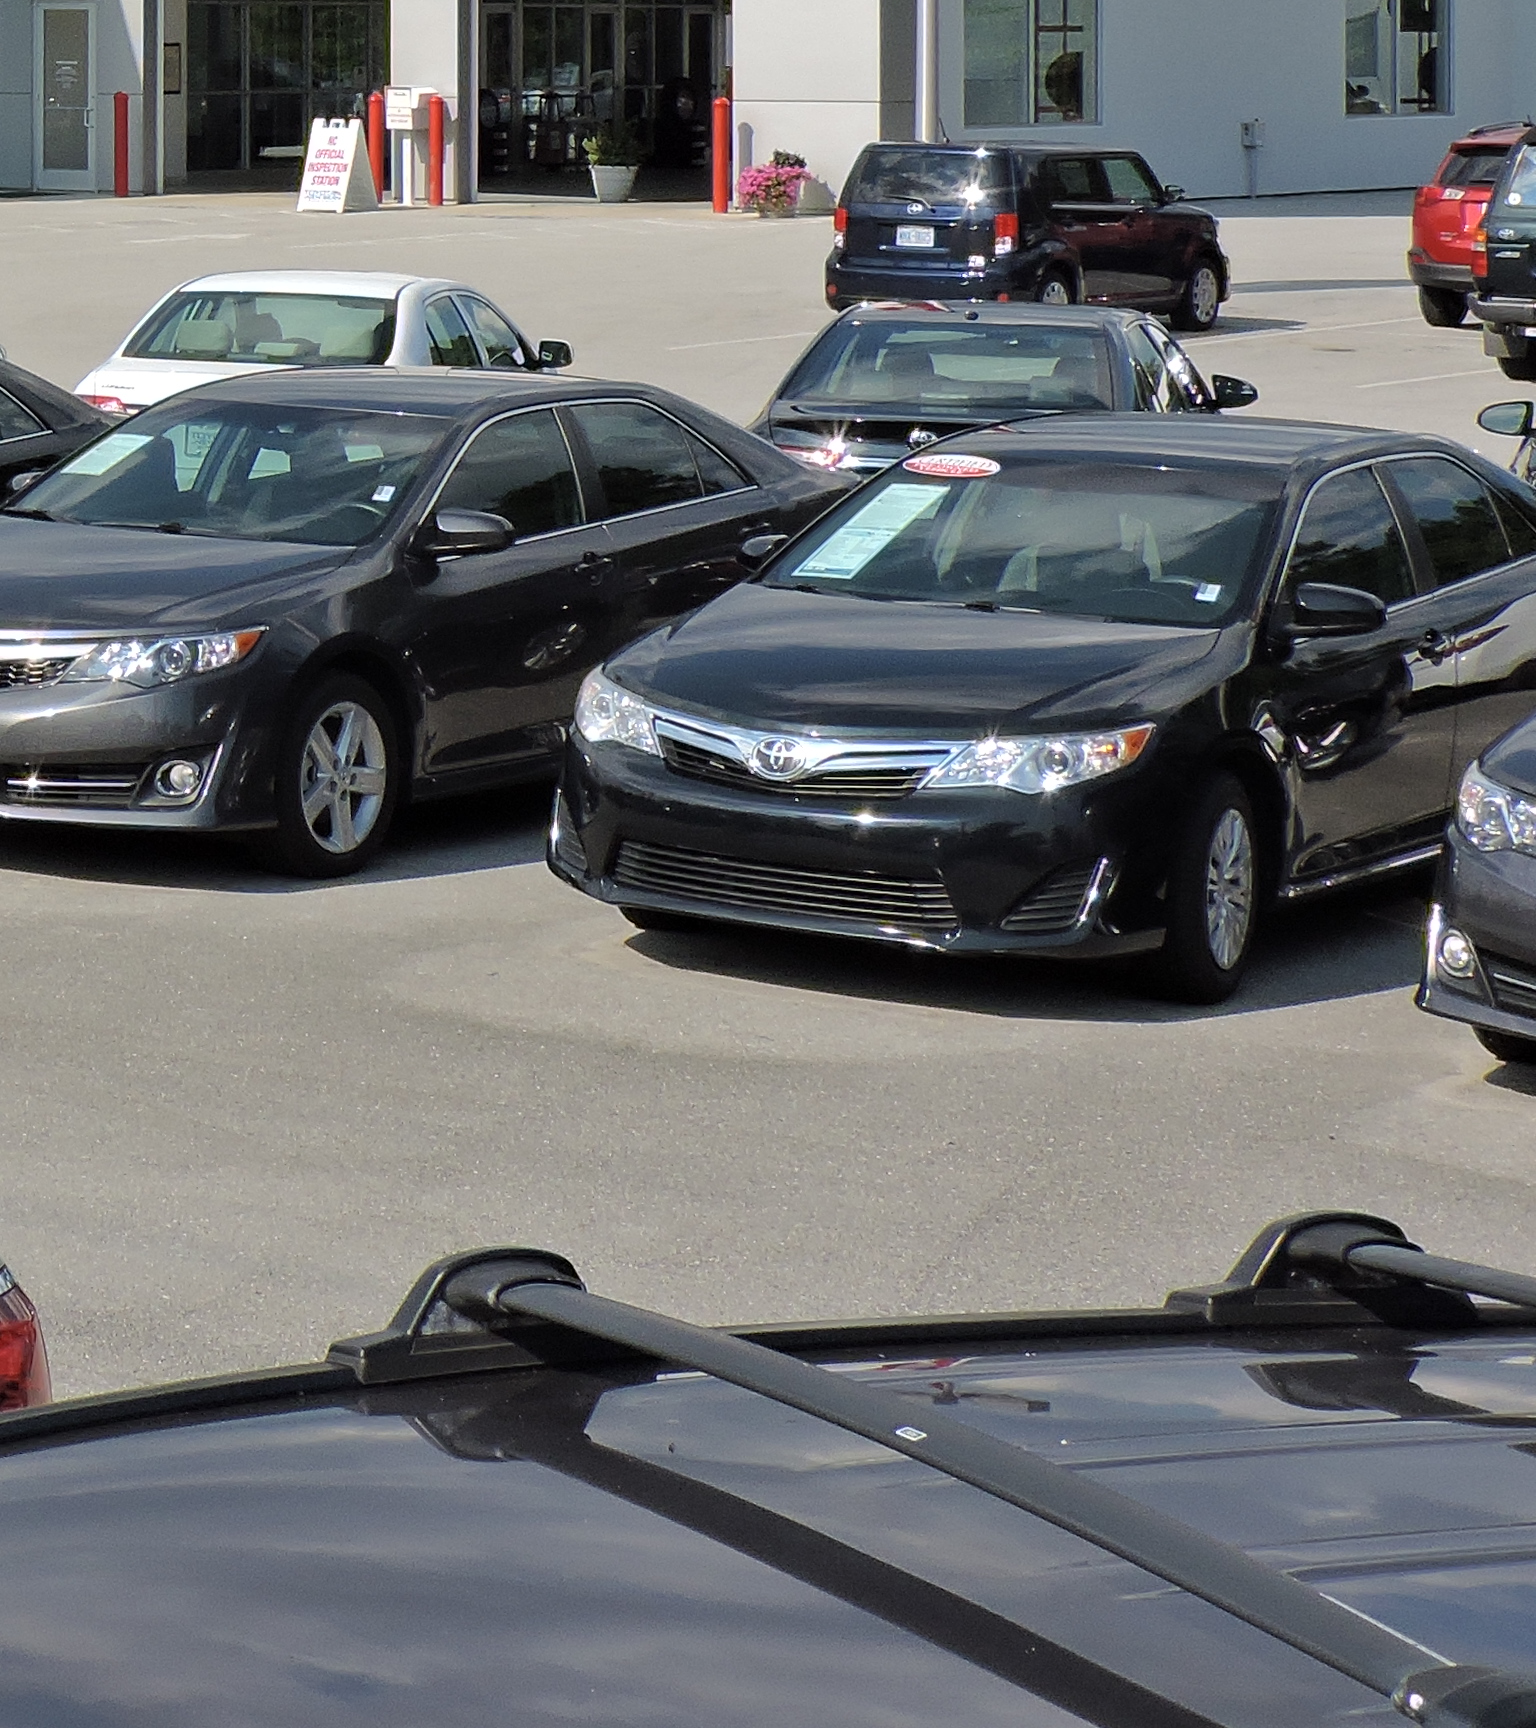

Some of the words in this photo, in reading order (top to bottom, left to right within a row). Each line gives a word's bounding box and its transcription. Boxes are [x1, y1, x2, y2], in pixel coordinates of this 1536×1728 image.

[315, 148, 345, 160] OFFICIAL
[308, 162, 349, 173] INSPECTION
[311, 175, 341, 186] STATION
